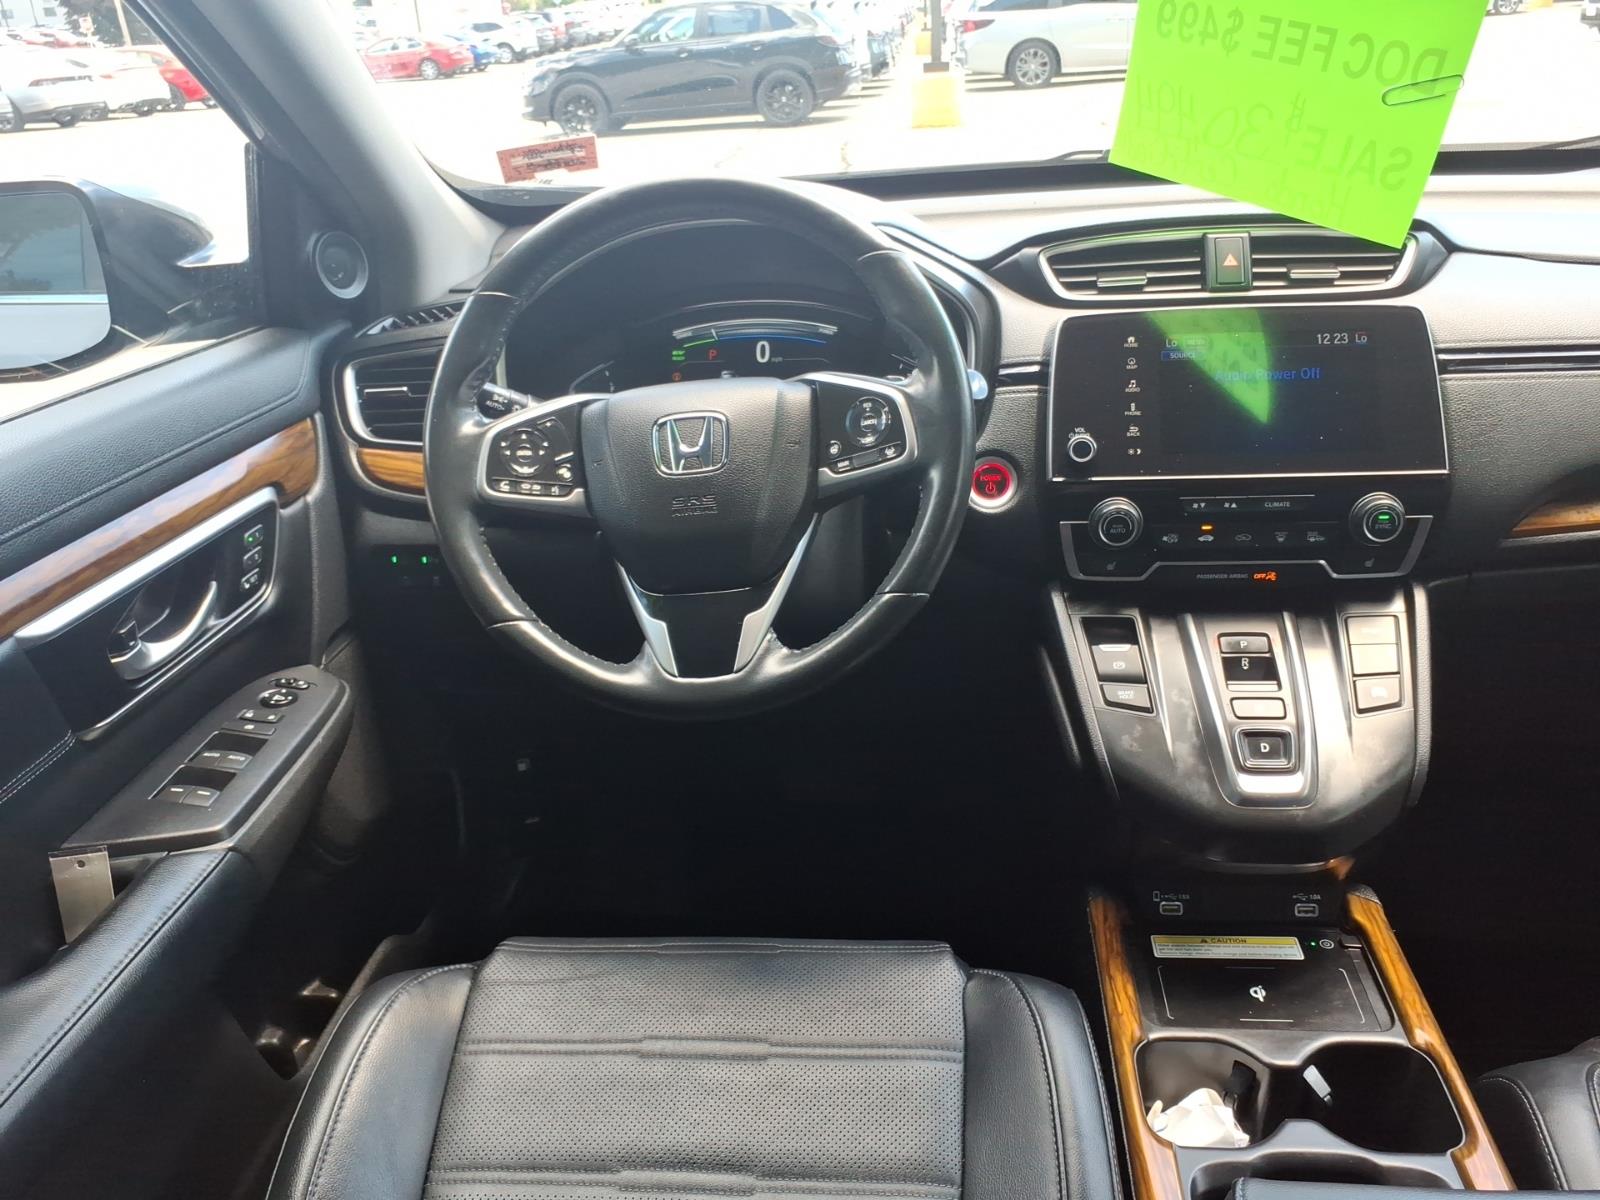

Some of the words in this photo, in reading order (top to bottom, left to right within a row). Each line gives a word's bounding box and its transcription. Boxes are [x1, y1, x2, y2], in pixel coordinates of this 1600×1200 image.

[709, 350, 717, 360] P
[755, 341, 770, 363] 0
[1255, 368, 1296, 380] Power
[1301, 367, 1320, 379] Off
[1240, 640, 1248, 649] P
[1260, 742, 1270, 752] D
